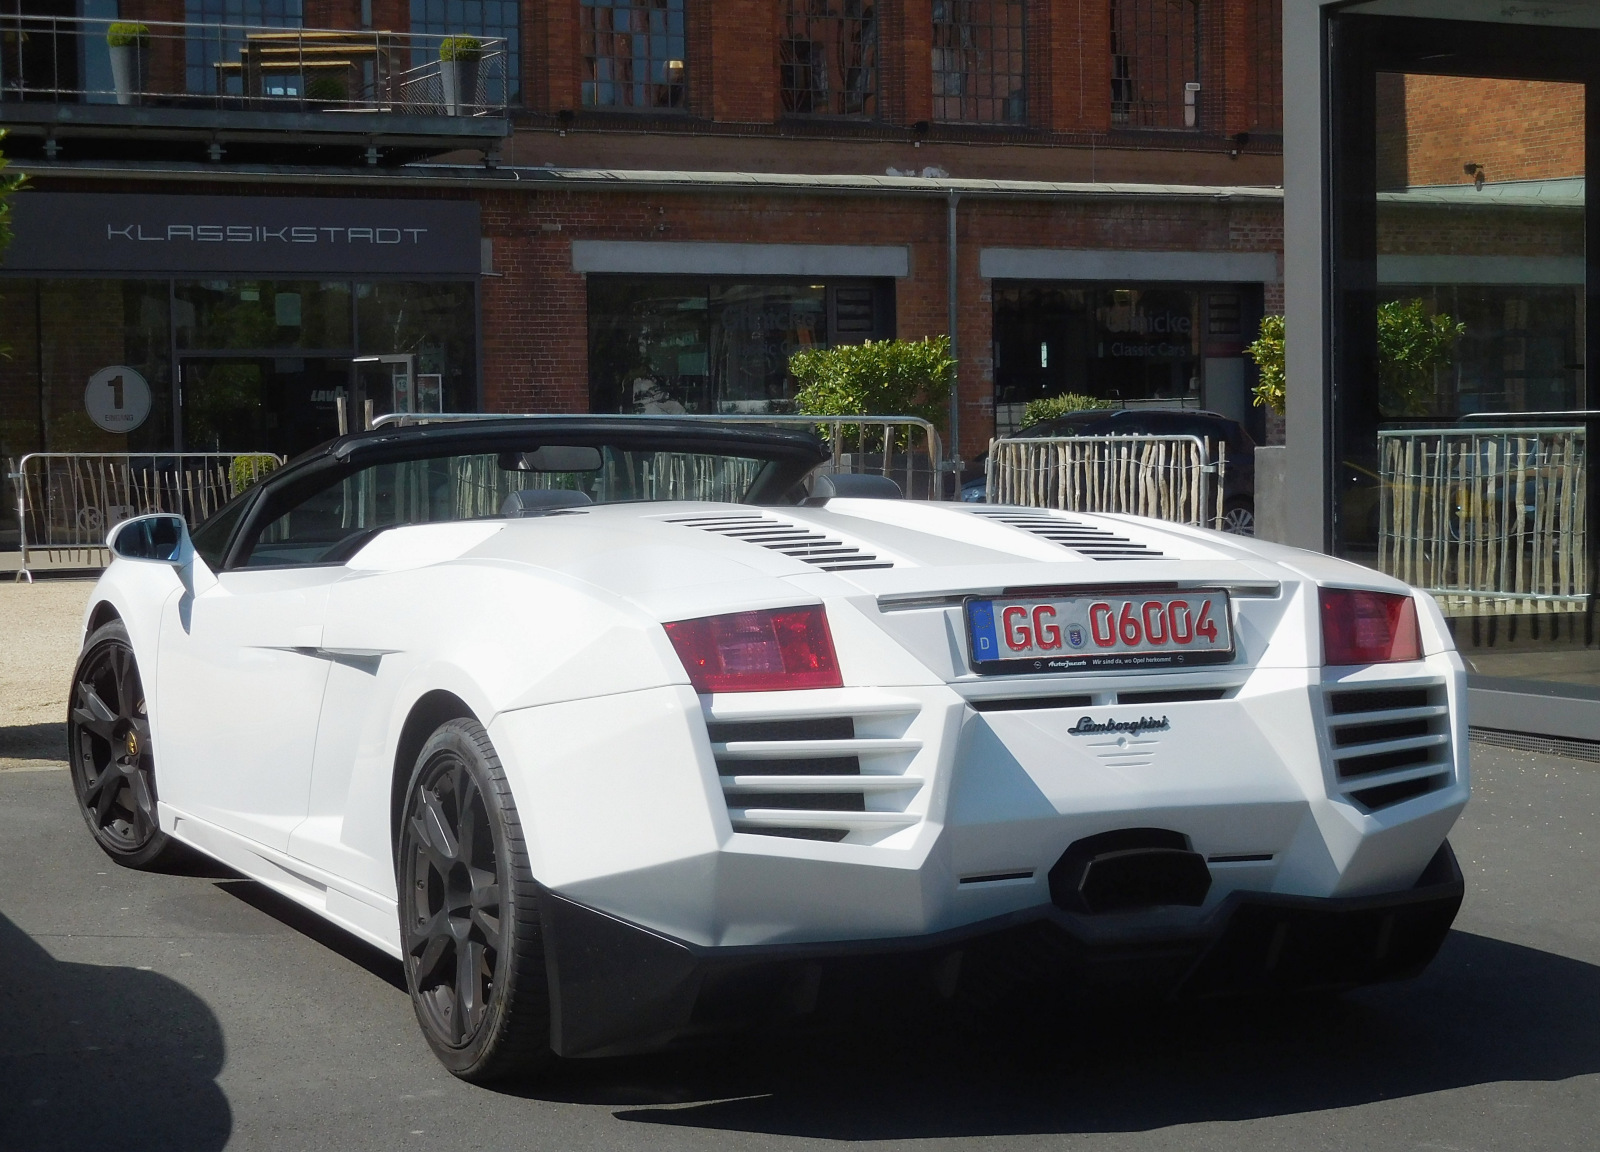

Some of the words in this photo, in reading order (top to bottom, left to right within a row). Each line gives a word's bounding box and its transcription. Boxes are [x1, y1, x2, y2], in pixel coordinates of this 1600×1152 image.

[106, 223, 429, 245] KLASSIKSTADT
[1111, 342, 1156, 357] Classic
[1158, 342, 1187, 357] Cars
[107, 375, 124, 410] 1
[104, 414, 134, 422] EINGANG
[1002, 605, 1062, 652] GG
[1088, 600, 1218, 648] 06004
[980, 636, 990, 650] D
[1067, 715, 1168, 734] Lamborghini
